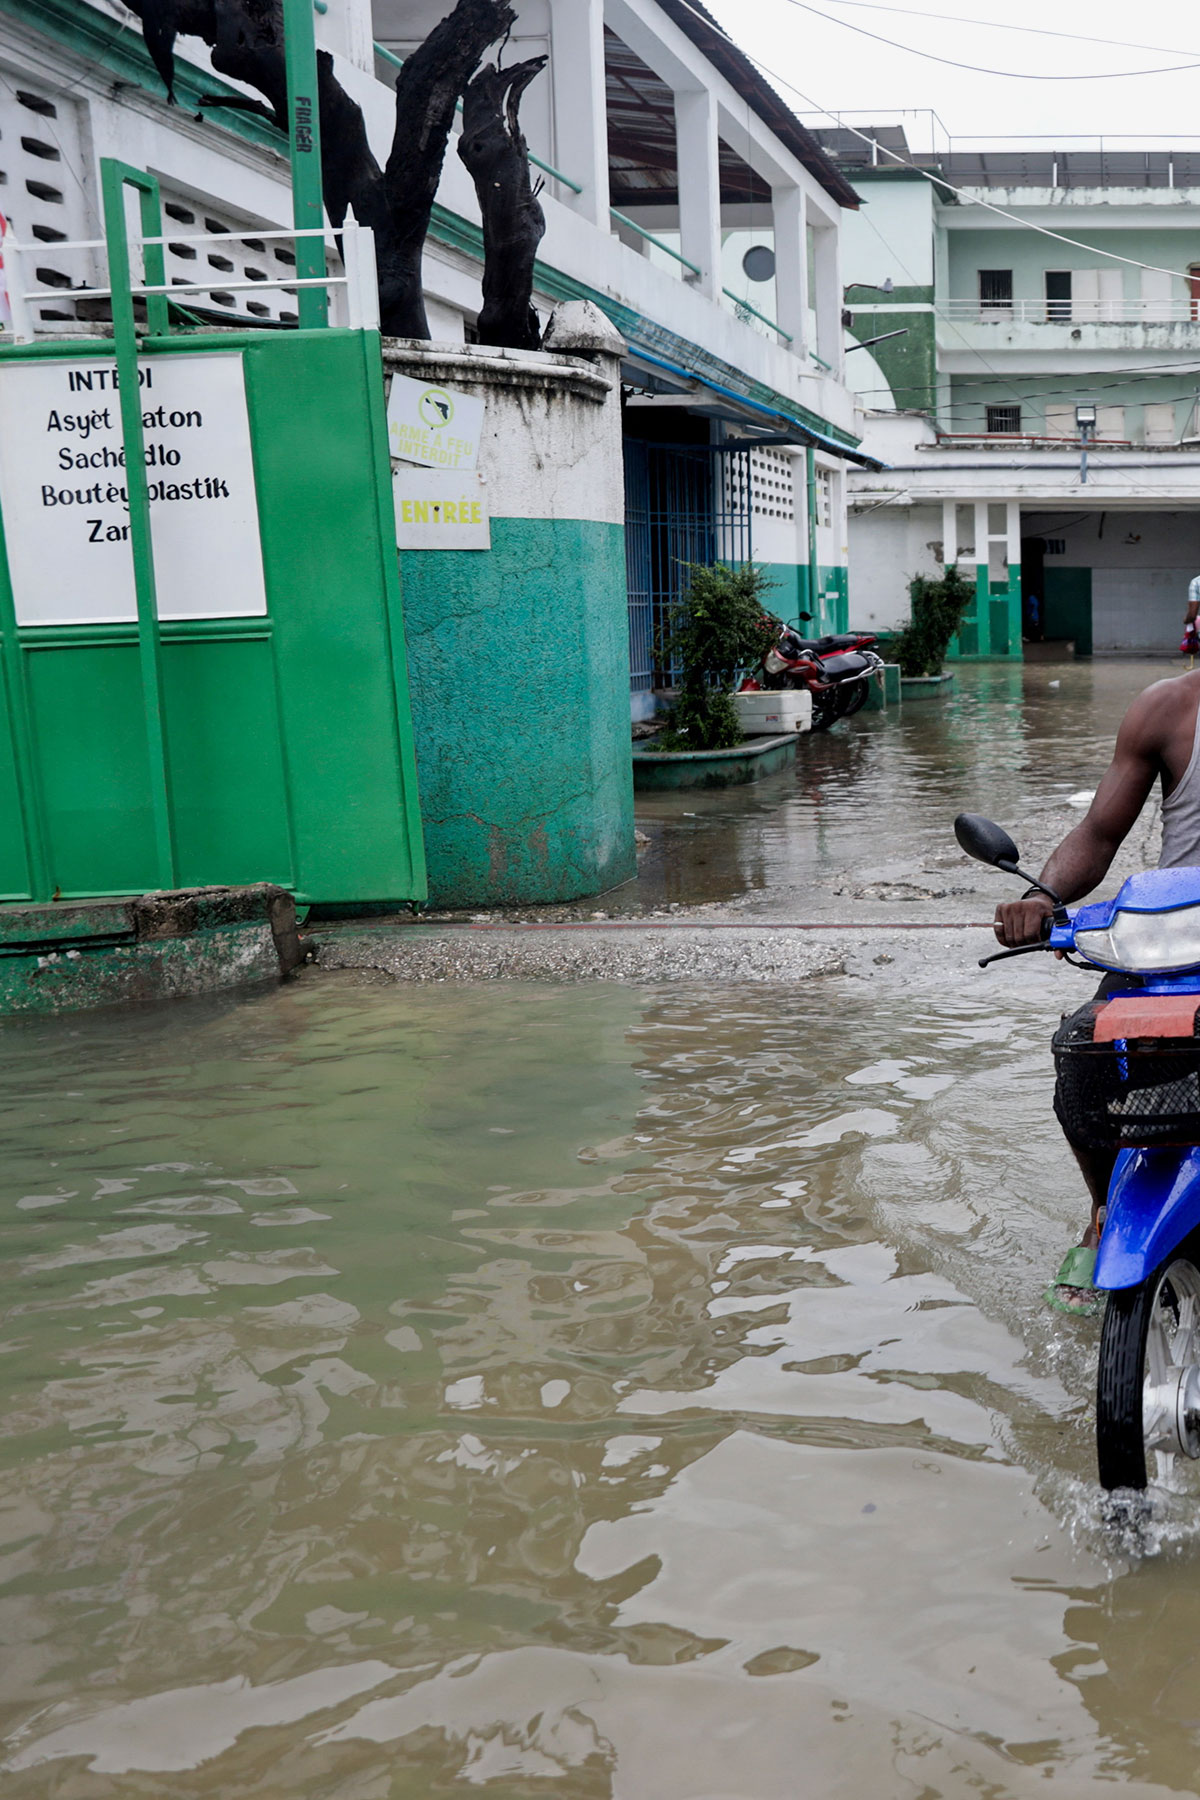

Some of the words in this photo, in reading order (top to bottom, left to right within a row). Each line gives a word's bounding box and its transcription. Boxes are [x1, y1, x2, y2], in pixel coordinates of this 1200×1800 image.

[47, 407, 114, 439] Asyèt
[141, 405, 203, 429] aton
[390, 422, 429, 444] ARME
[447, 438, 473, 456] FEU
[397, 439, 462, 466] INTERDIT
[144, 443, 182, 467] dlo
[401, 494, 482, 524] ENTRÉE
